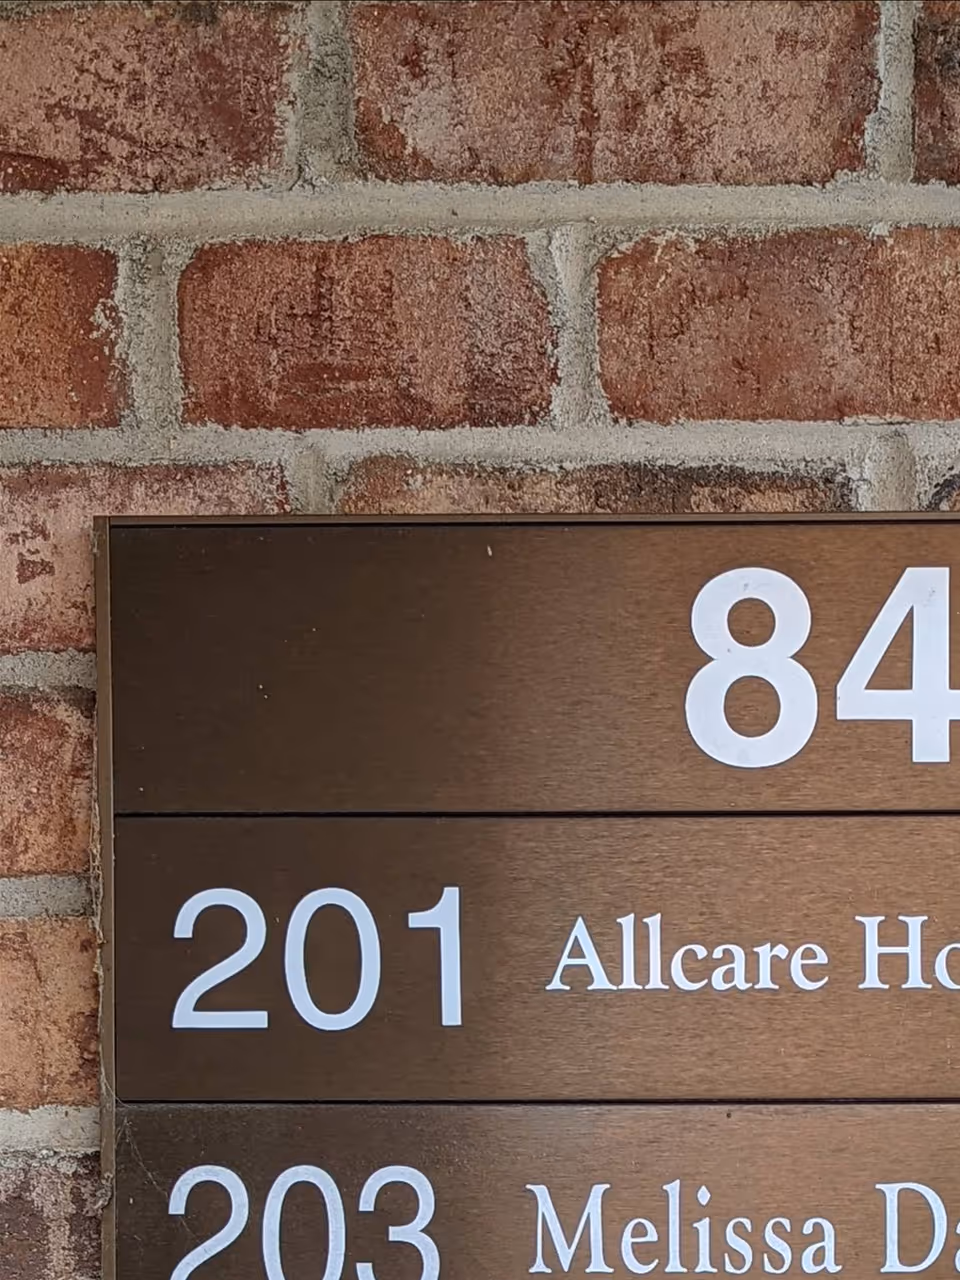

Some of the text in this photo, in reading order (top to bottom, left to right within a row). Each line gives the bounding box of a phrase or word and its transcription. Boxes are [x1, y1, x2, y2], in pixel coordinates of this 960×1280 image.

[171, 886, 464, 1031] 201
[545, 913, 829, 992] Allcare
[526, 1178, 843, 1275] Melissa
